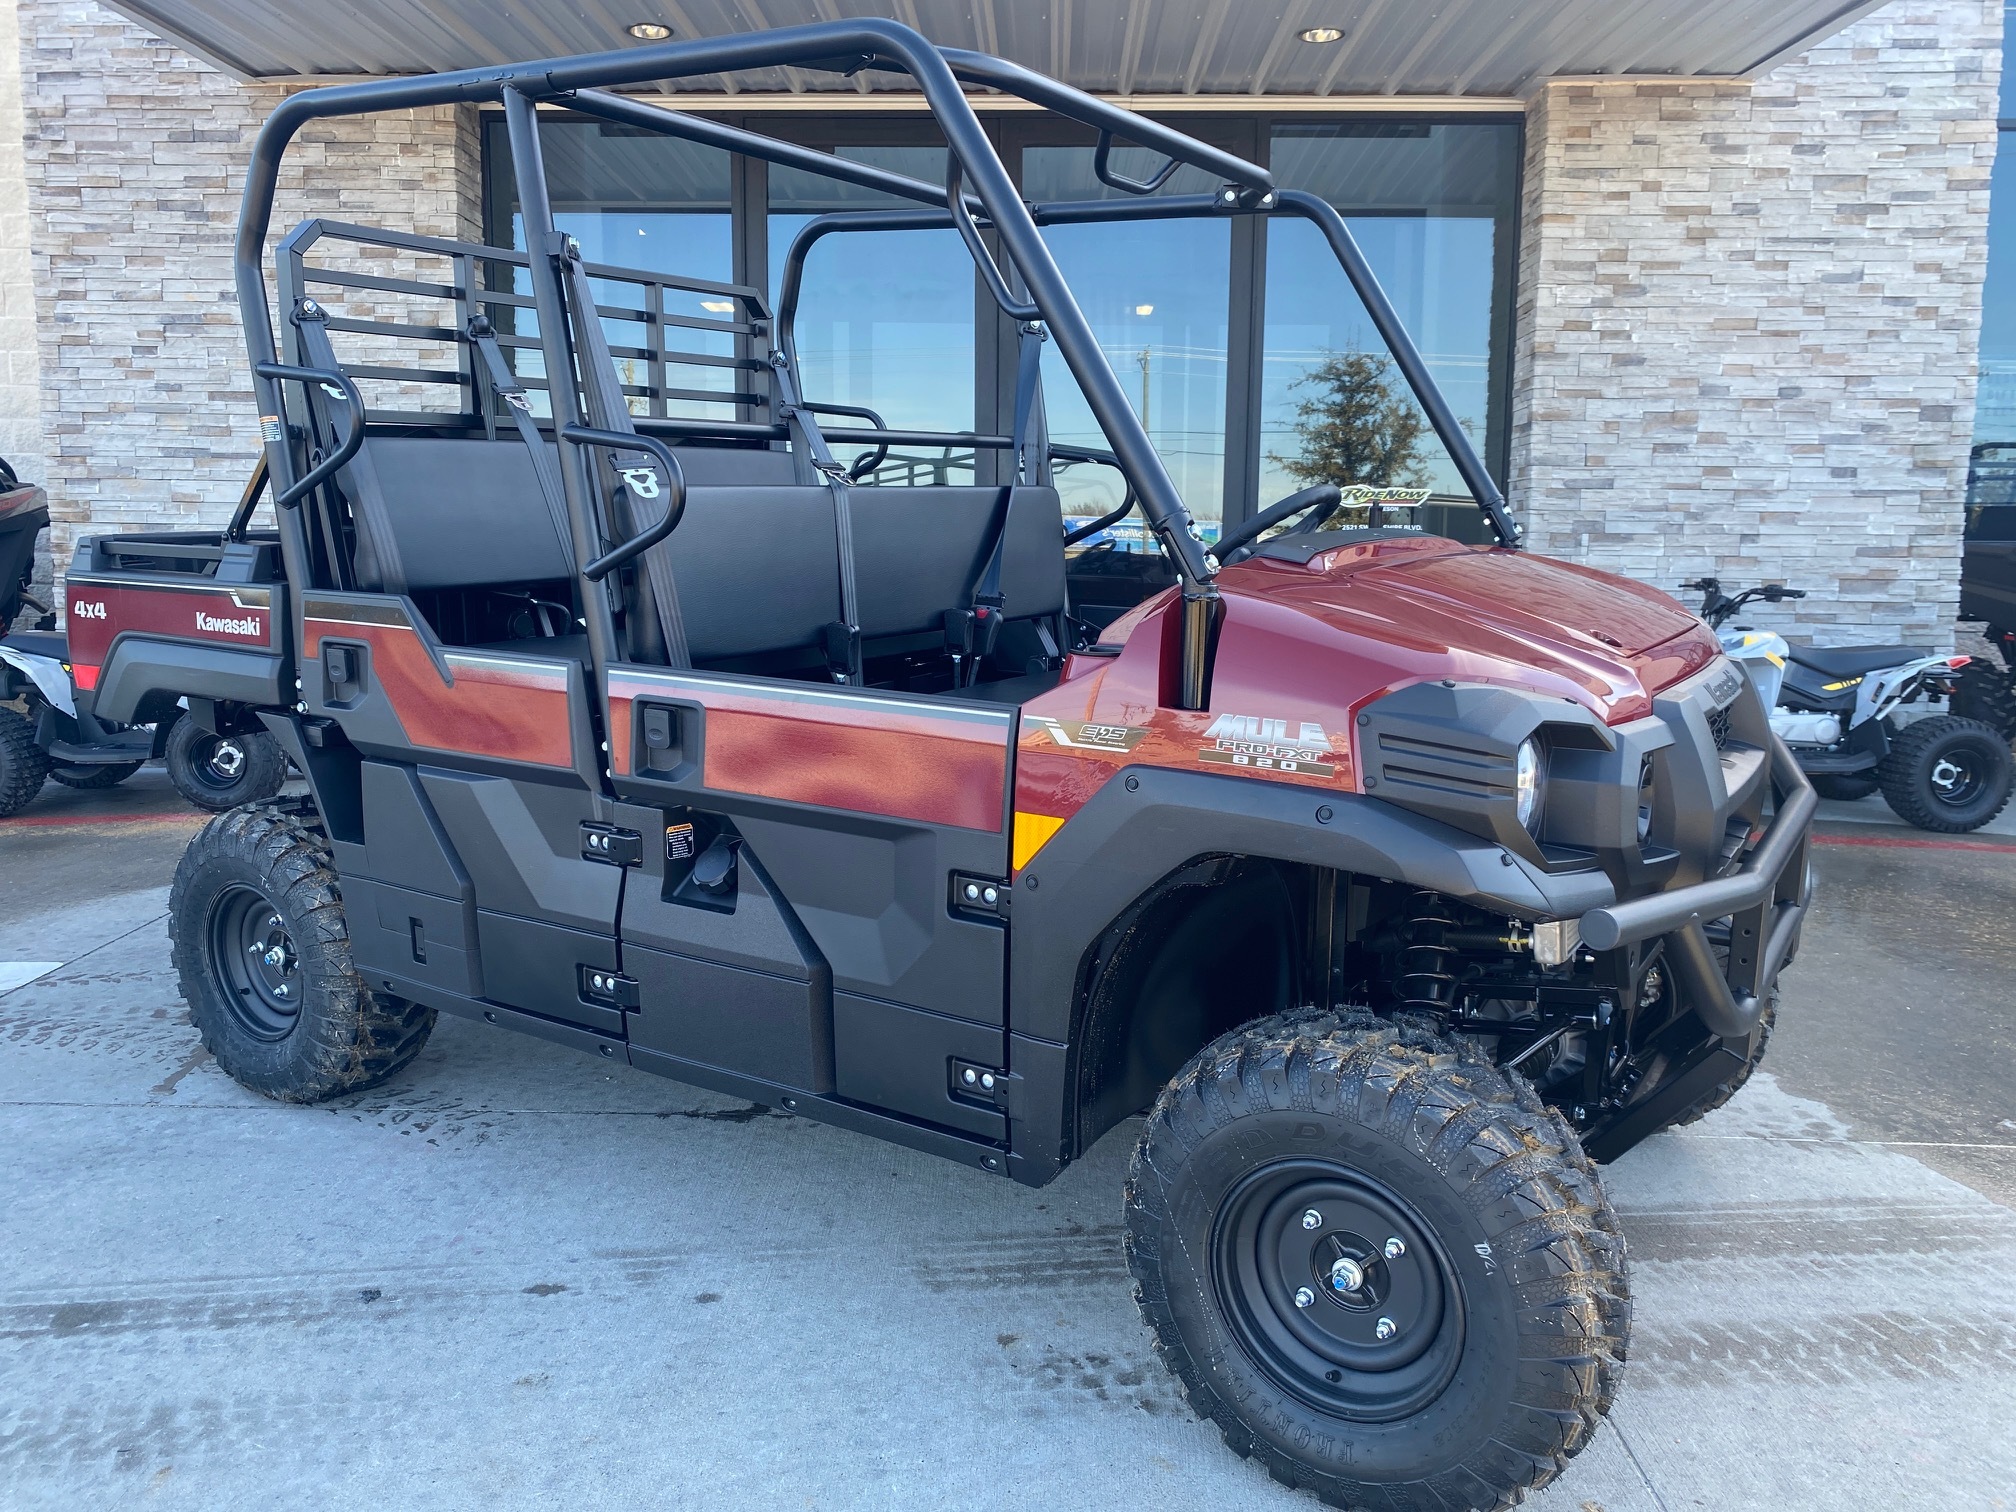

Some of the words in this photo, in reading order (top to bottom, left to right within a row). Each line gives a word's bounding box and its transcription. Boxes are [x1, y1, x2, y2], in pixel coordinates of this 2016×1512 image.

[74, 600, 107, 620] 4x4
[196, 611, 261, 636] Kawasaki
[1203, 713, 1333, 751] MULE
[1216, 739, 1323, 761] PRO-FXT
